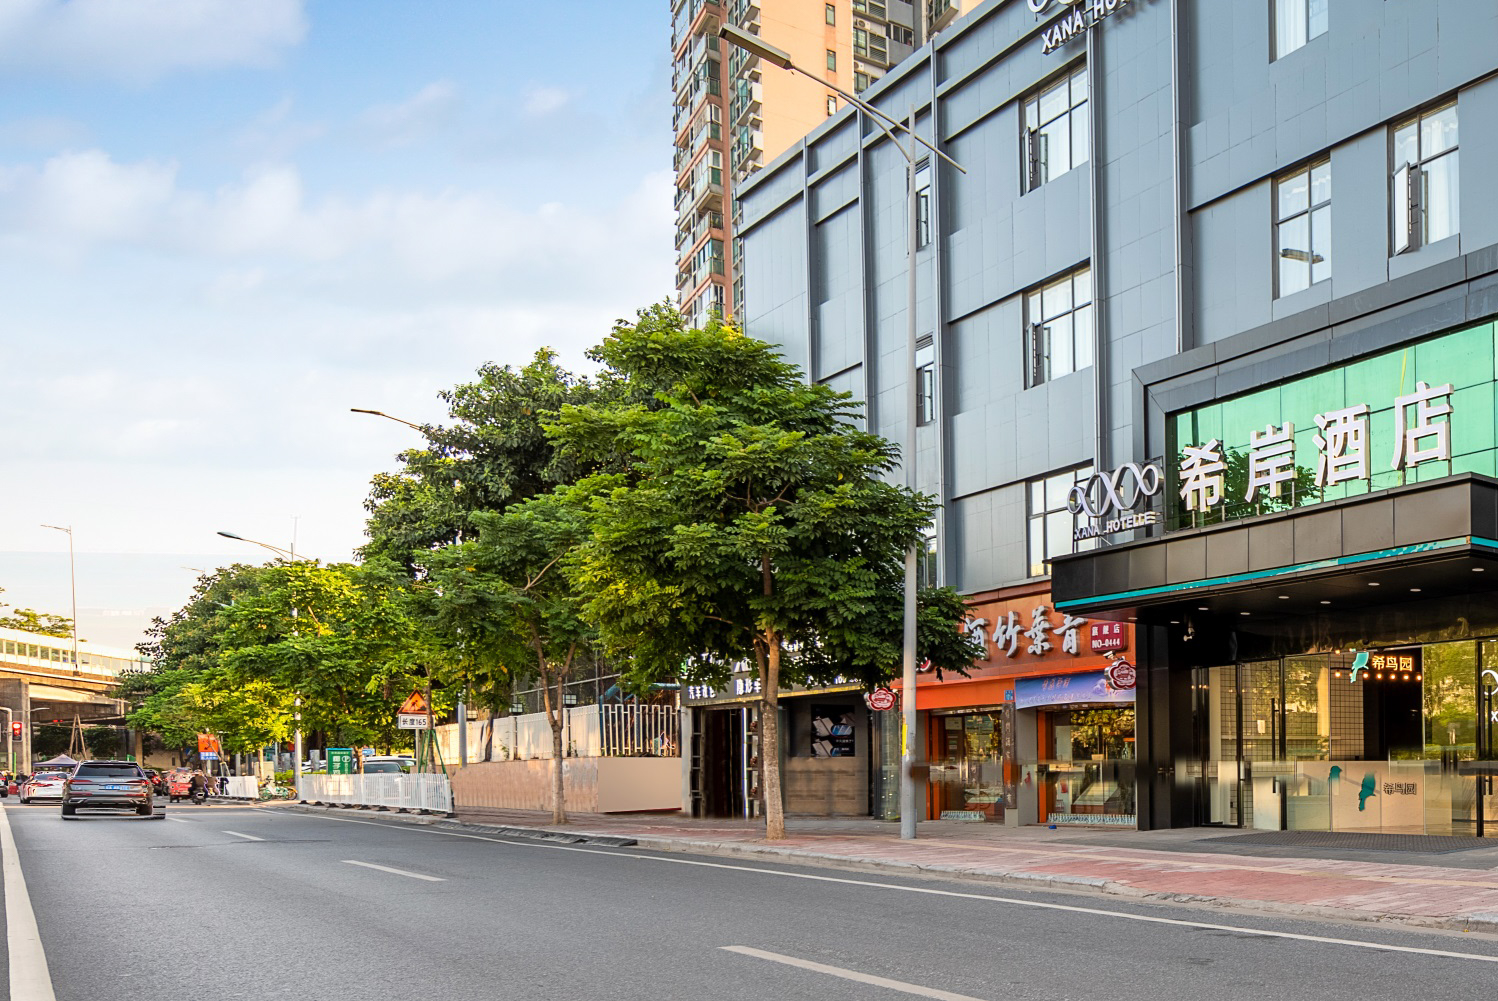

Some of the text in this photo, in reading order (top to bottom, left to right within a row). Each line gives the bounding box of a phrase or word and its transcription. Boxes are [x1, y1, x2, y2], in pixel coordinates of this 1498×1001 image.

[1041, 10, 1085, 55] XANA
[1179, 381, 1454, 513] 希岸酒店
[1075, 511, 1156, 539] XANA HOTELLE
[1372, 655, 1413, 671] 希鸟园
